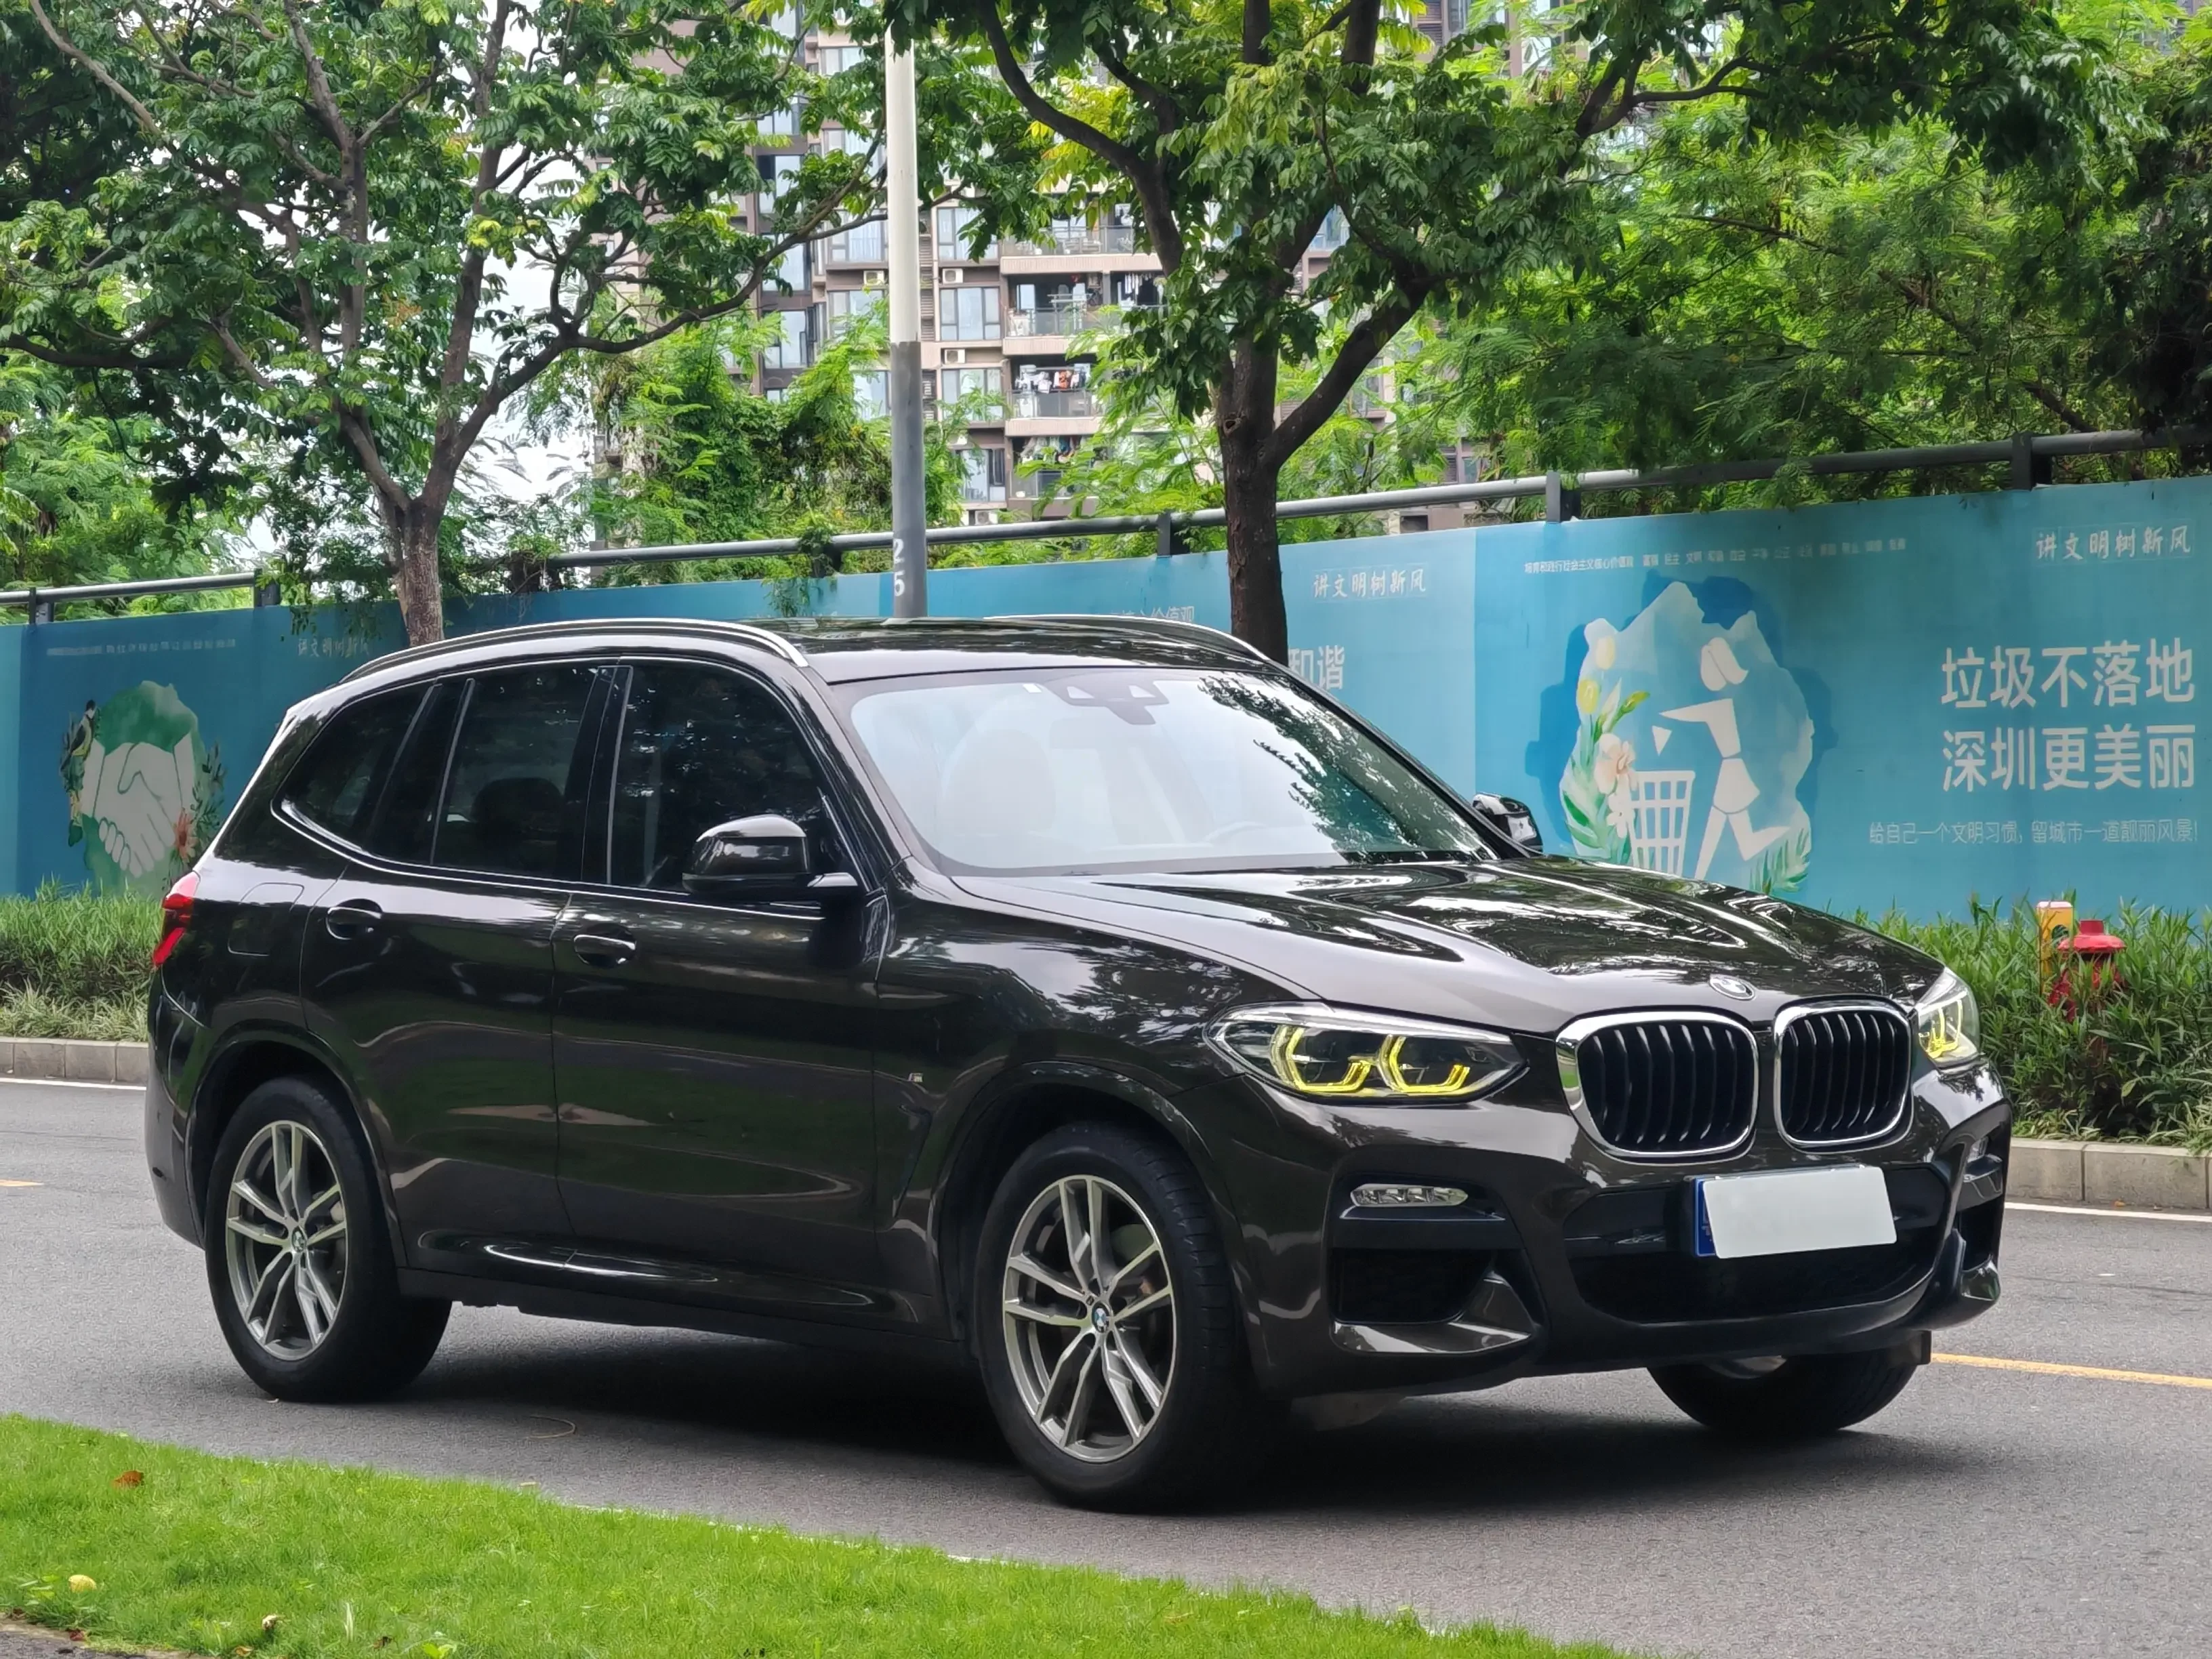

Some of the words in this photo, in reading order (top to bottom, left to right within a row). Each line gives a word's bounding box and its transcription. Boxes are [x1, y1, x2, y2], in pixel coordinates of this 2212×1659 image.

[2035, 525, 2191, 561] 讲文明树新风
[1313, 569, 1426, 598] 讲文明树新风
[1288, 644, 1345, 690] 和谐
[1941, 638, 2195, 709] 垃圾不落地
[1943, 724, 2196, 792] 深圳更美丽
